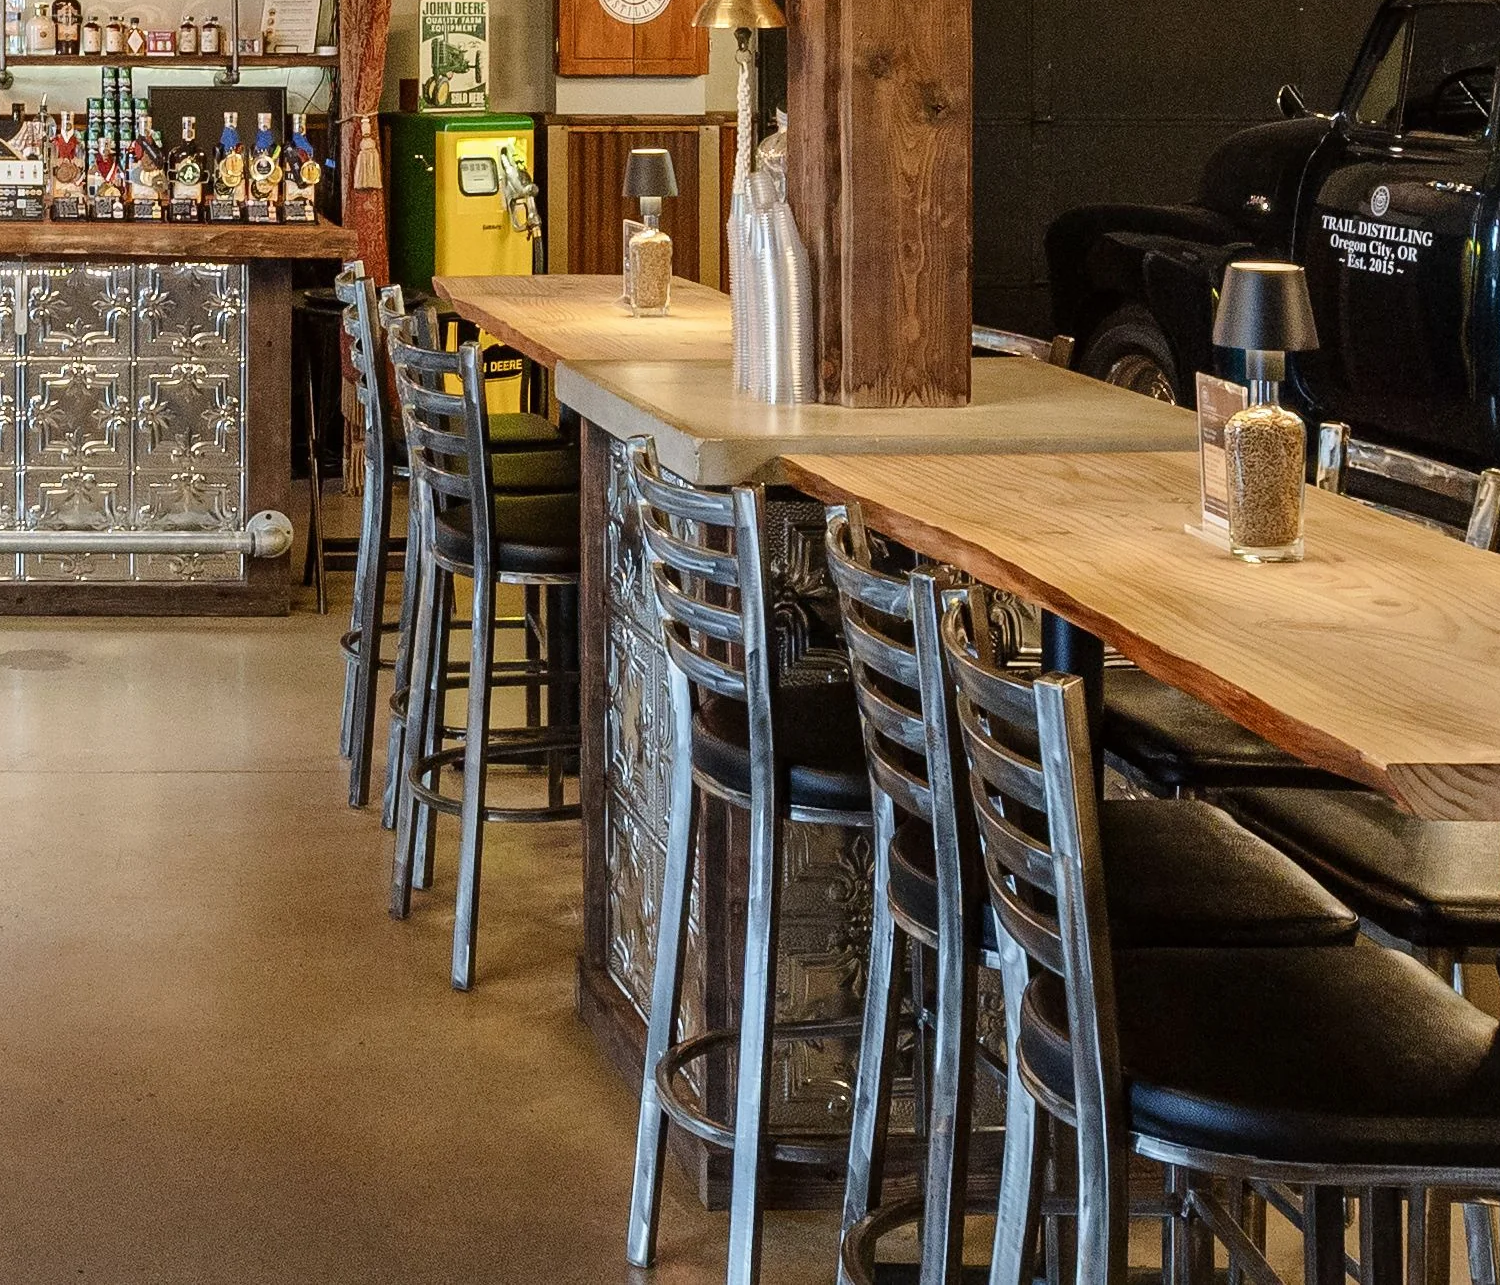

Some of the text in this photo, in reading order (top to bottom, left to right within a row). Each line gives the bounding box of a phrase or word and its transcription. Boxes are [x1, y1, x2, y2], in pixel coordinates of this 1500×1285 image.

[422, 2, 485, 15] JOHN DEERE
[431, 24, 477, 32] EQUIPMENT
[451, 92, 485, 104] SOLD HERE
[1322, 215, 1433, 247] TRAIL DISTILLING
[1330, 233, 1418, 263] Oregon City, OR
[1347, 253, 1367, 270] Est.
[1369, 257, 1395, 275] 2015
